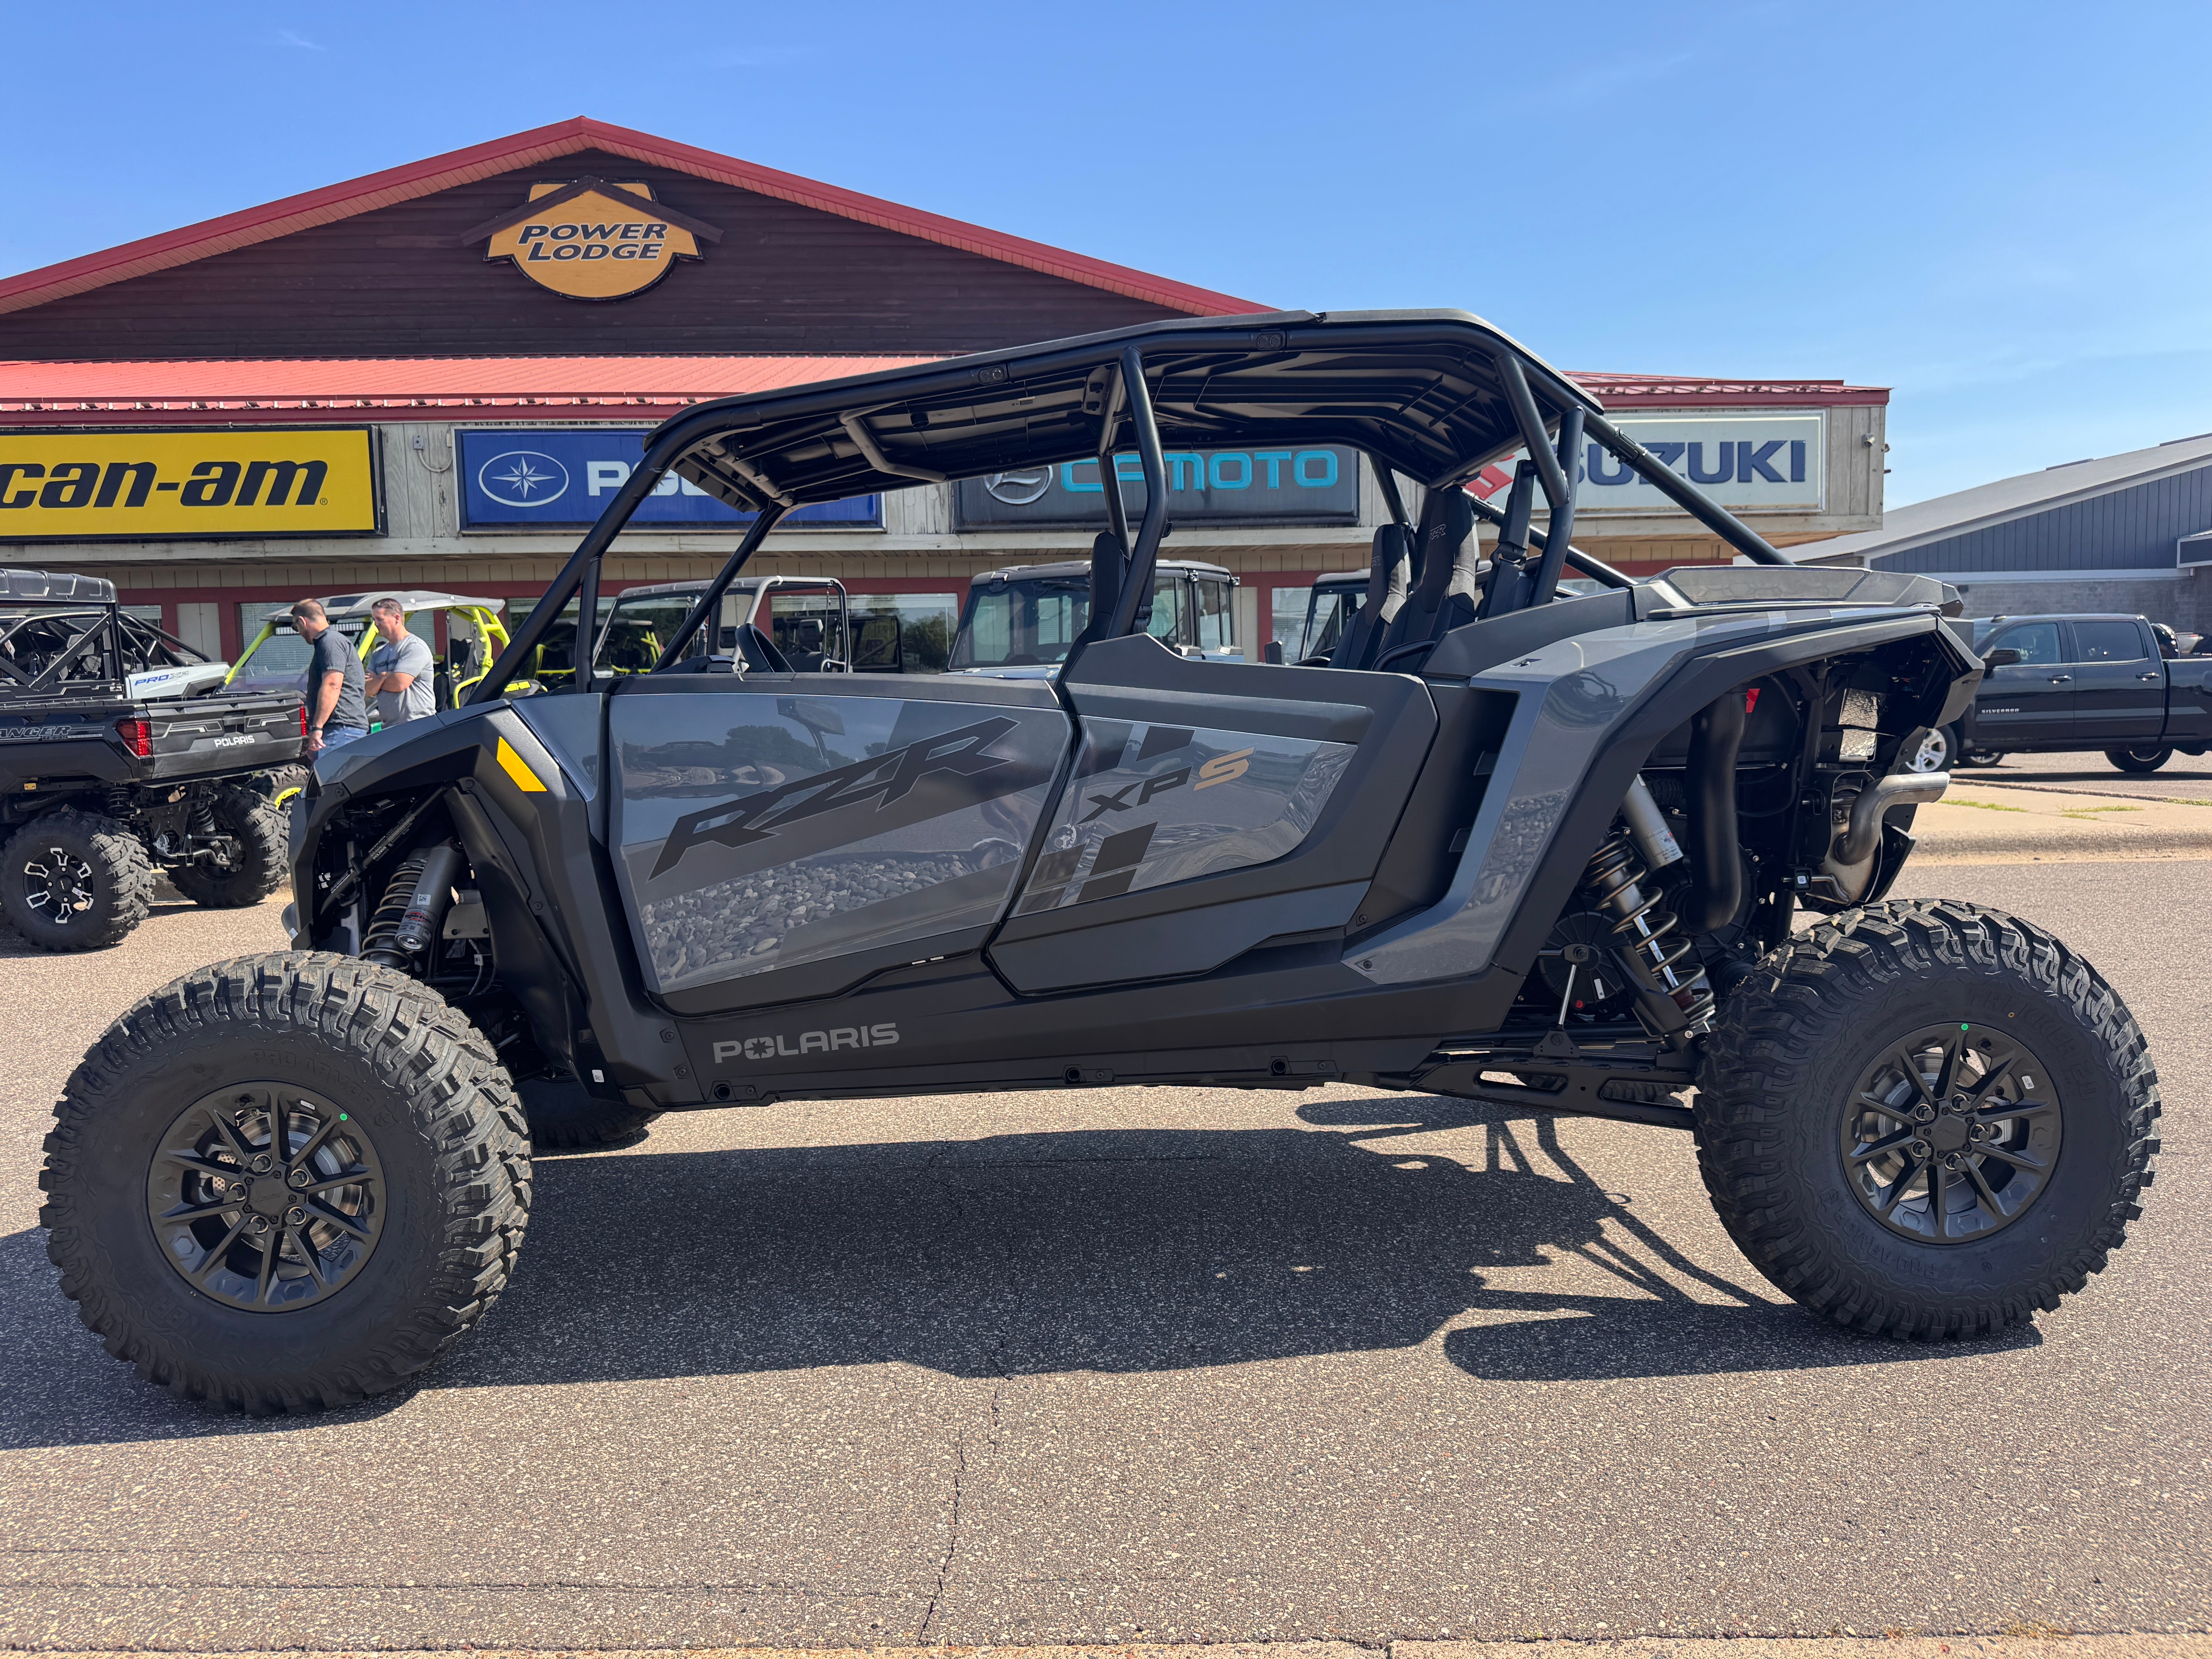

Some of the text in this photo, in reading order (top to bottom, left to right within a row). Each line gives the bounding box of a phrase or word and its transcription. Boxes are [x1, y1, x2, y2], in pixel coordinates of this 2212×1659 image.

[518, 223, 668, 244] POWER
[527, 242, 663, 261] LODGE
[1536, 440, 1805, 485] UZUKI
[0, 725, 71, 738] ANGER
[214, 735, 255, 747] POLARIS
[1077, 744, 1258, 824] XP S
[645, 716, 1021, 884] RZR
[713, 1023, 900, 1063] POLARIS
